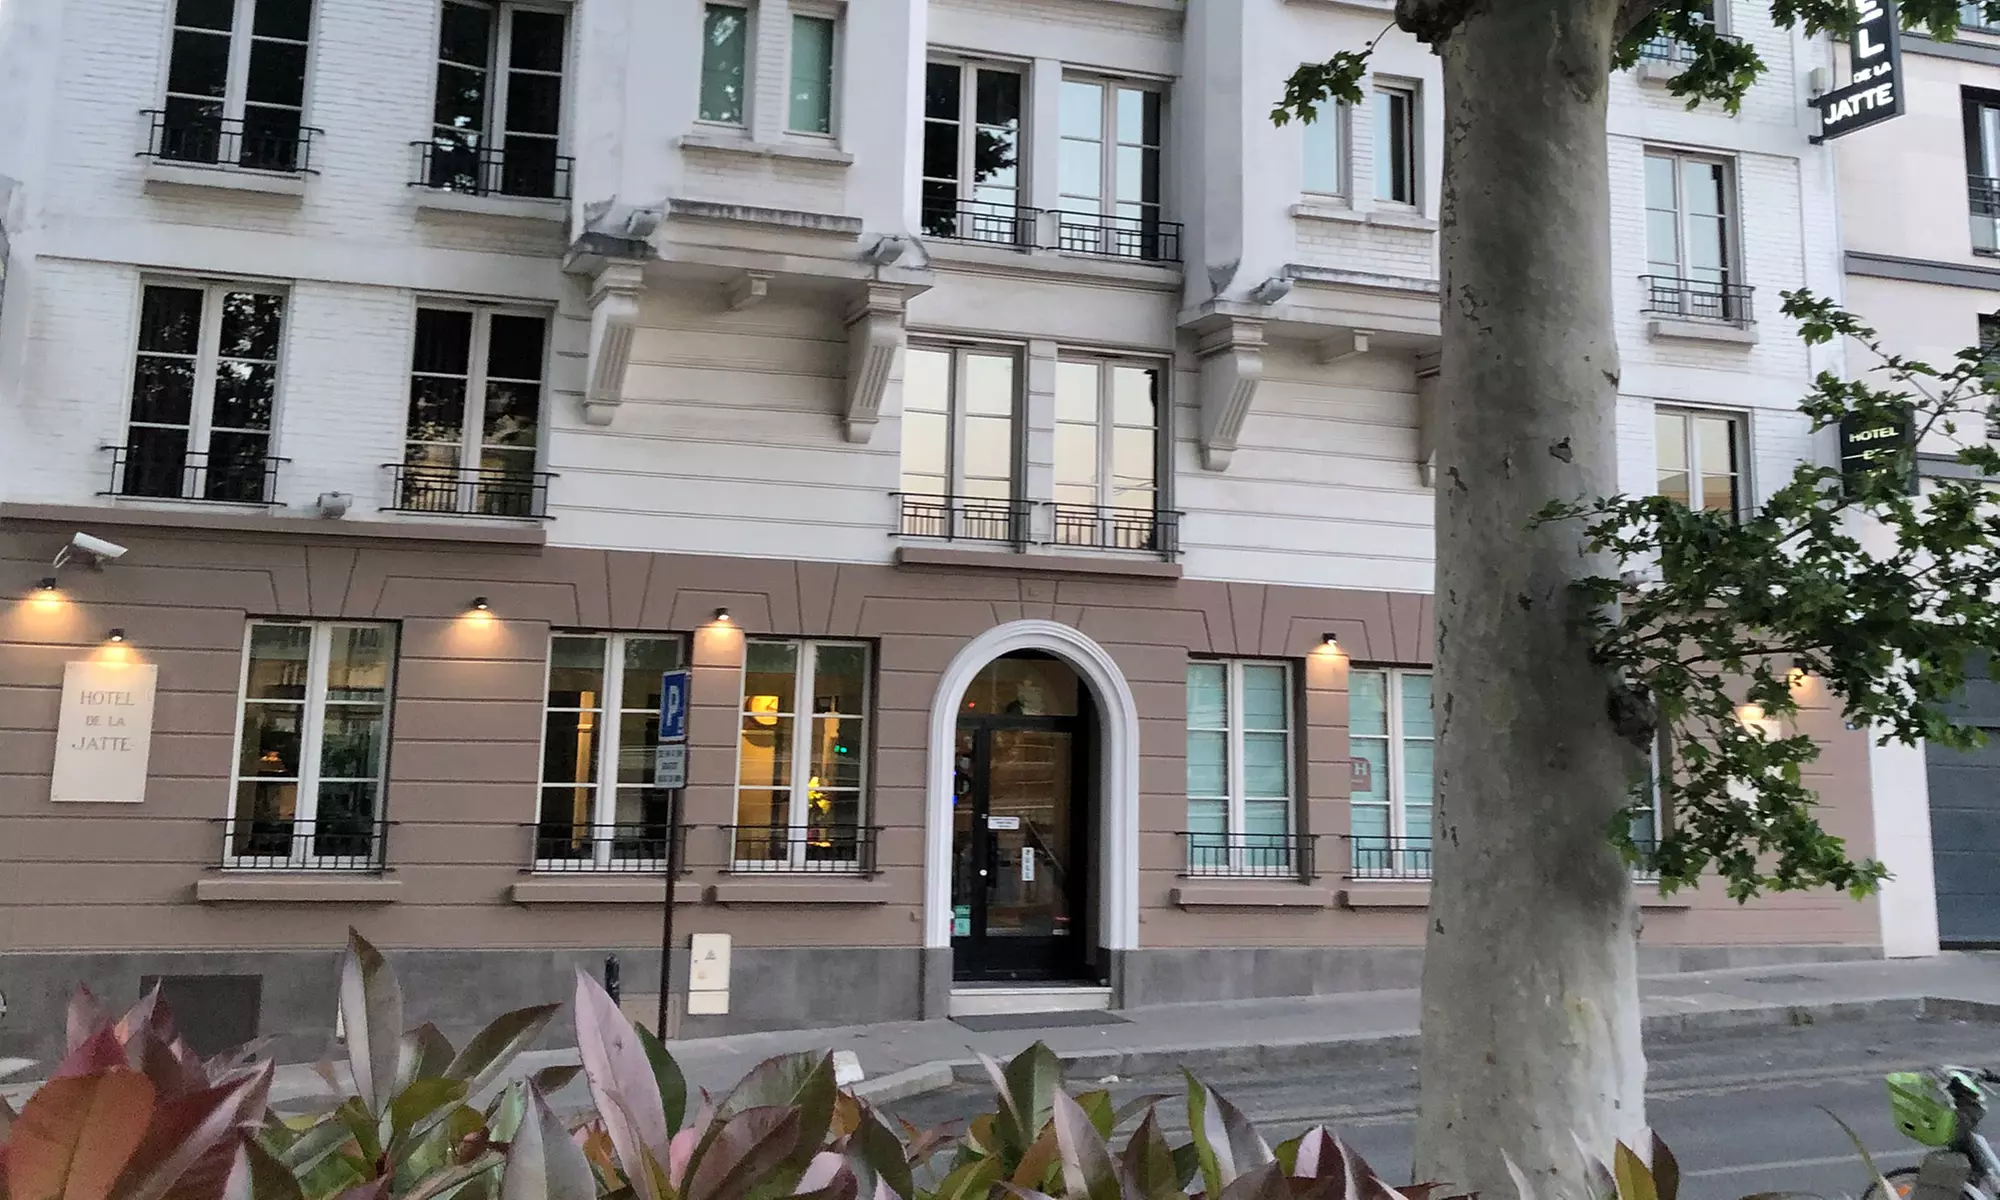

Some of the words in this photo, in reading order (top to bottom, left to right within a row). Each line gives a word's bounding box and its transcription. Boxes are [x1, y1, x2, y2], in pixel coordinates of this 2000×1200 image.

[1853, 69, 1873, 84] DE
[1873, 61, 1892, 77] LA
[1824, 82, 1895, 125] JATTE
[1848, 426, 1900, 443] HOTEL
[79, 690, 135, 707] HOTEL
[666, 685, 680, 727] P
[85, 715, 103, 727] DE
[107, 715, 127, 727] LA
[71, 736, 133, 752] JATTE
